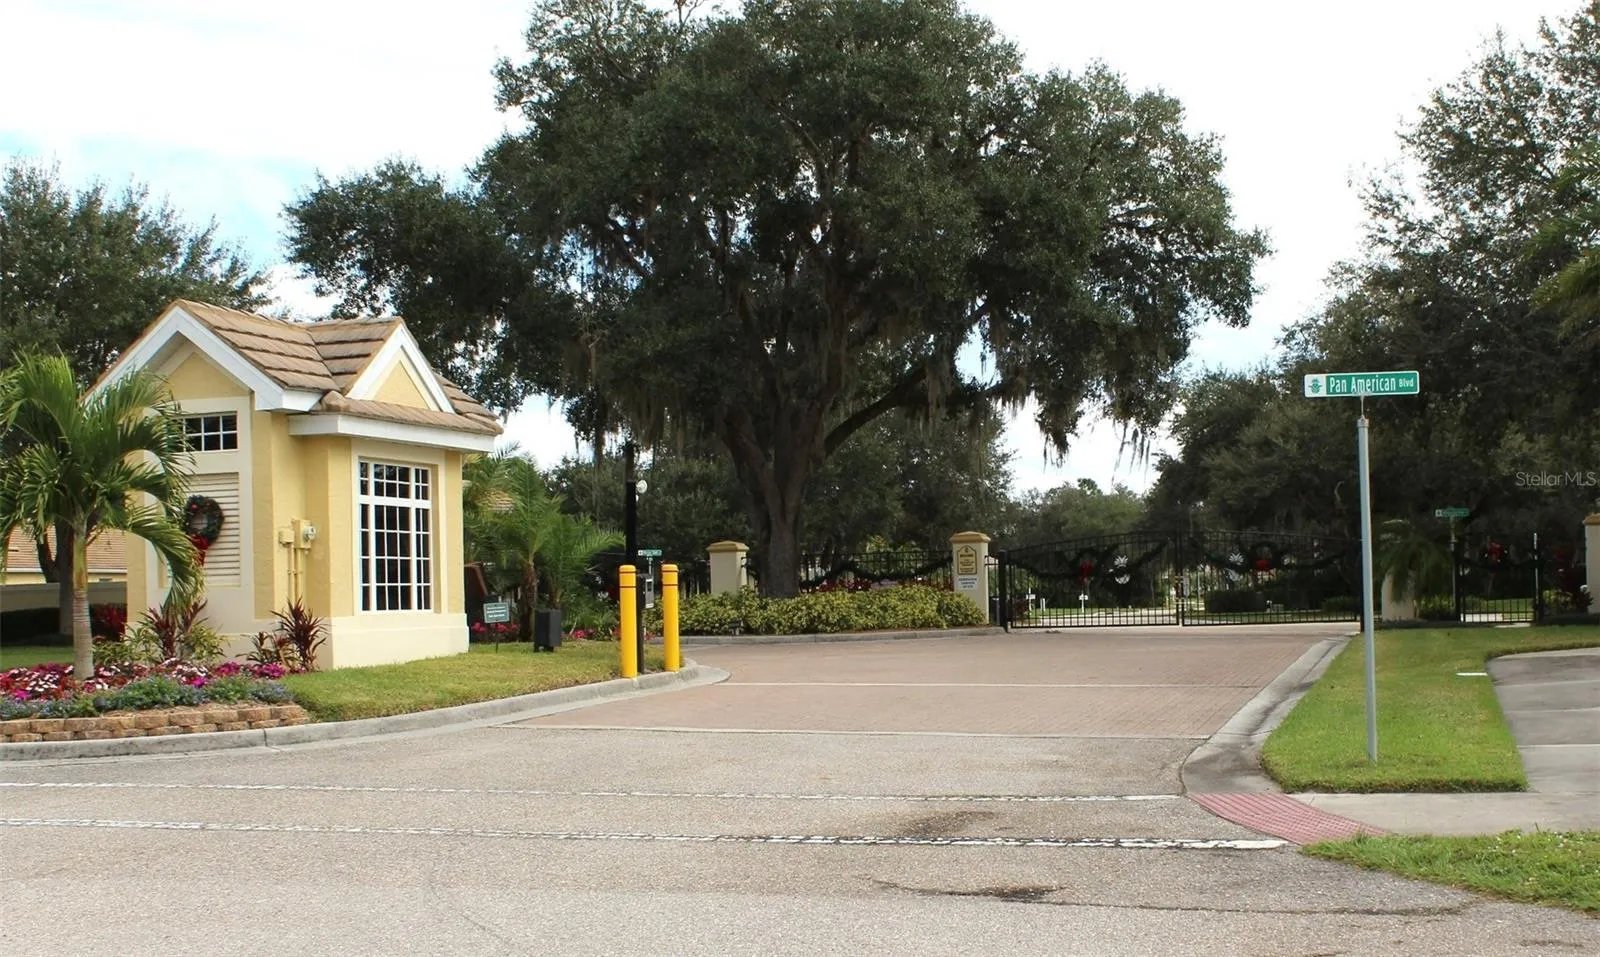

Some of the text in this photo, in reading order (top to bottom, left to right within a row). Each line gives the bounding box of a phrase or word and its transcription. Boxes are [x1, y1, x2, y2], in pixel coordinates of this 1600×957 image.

[1330, 375, 1414, 393] Pan American Blvd
